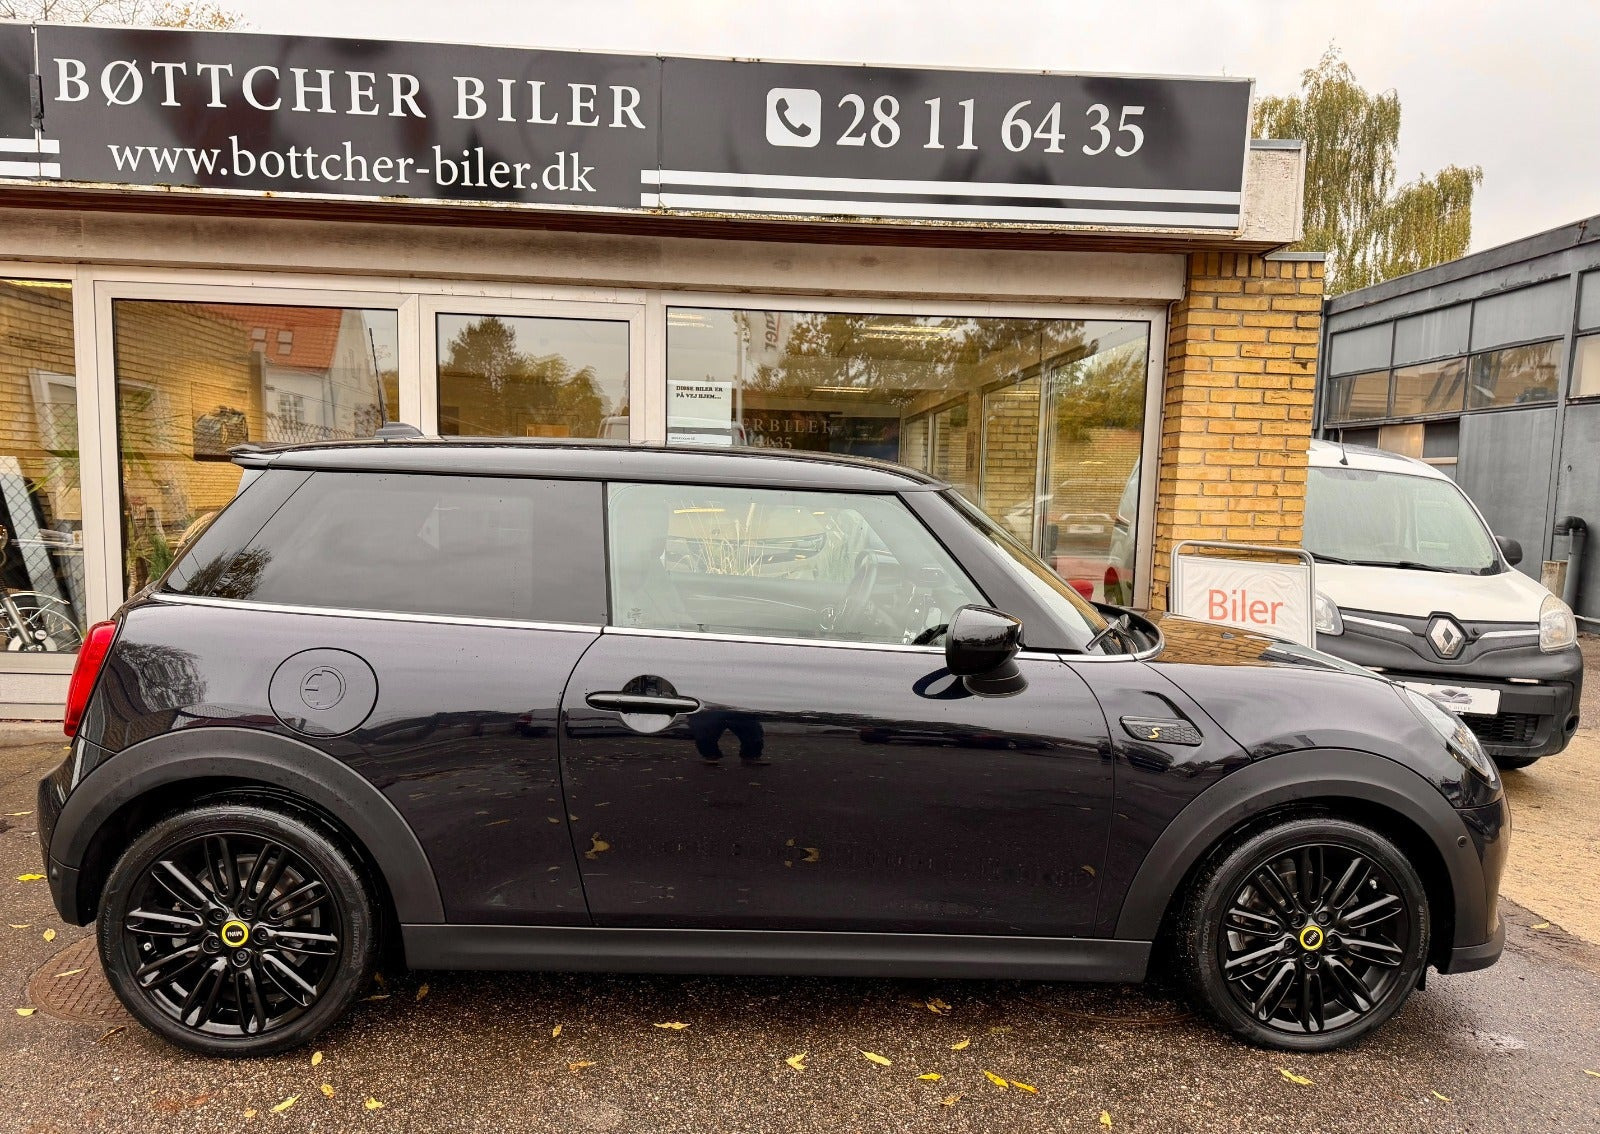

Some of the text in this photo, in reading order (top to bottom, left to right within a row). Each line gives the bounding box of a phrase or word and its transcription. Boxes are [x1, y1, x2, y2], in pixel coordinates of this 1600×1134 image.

[53, 57, 646, 130] BØTTCHER BILER
[836, 93, 1145, 157] 28 11 64 35
[107, 135, 597, 193] www.bottcher-biler.dk
[1208, 589, 1284, 625] Biler
[1147, 726, 1161, 740] S
